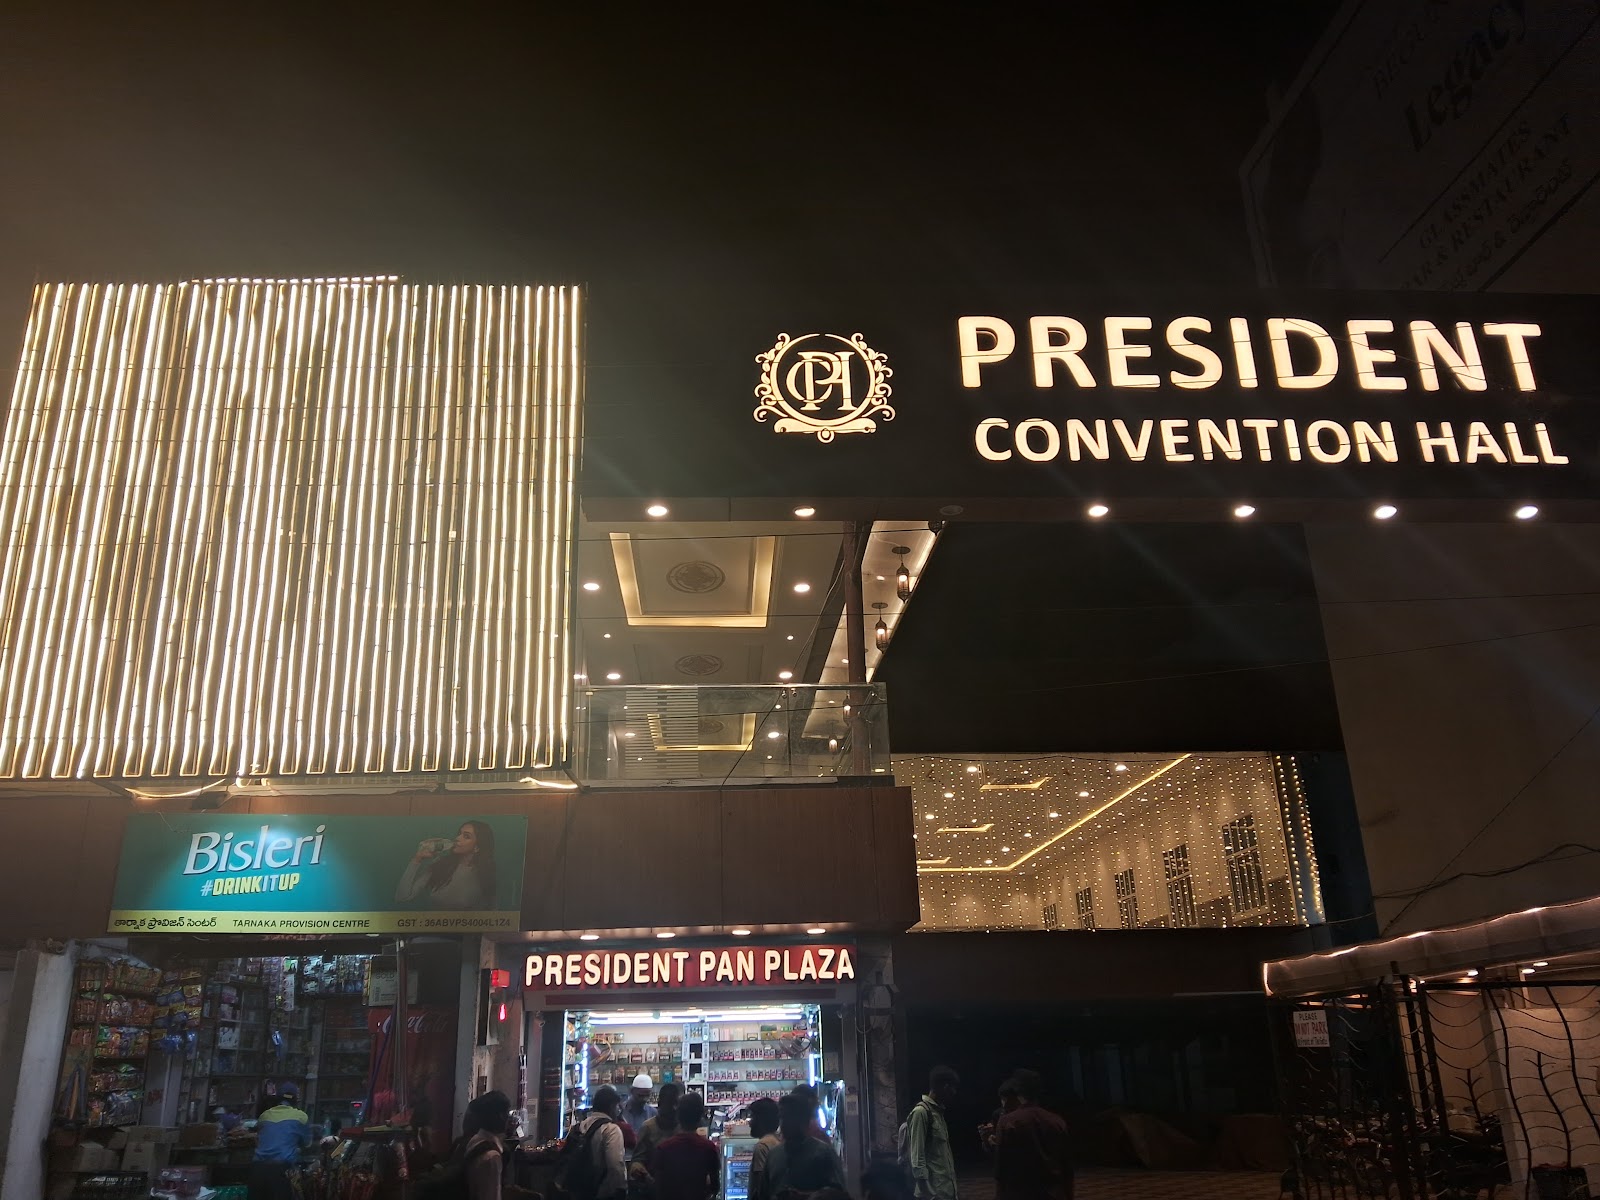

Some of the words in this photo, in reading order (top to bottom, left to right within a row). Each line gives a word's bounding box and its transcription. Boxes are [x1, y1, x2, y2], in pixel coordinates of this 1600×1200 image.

[958, 316, 1541, 392] PRESIDENT
[976, 418, 1398, 463] CONVENTION
[1416, 422, 1568, 465] HALL
[183, 824, 326, 875] Bisleri
[200, 873, 300, 897] #DRINKITUP
[233, 919, 277, 928] TARNAKA
[279, 919, 329, 928] PROVISION
[332, 919, 370, 928] CENTRE
[397, 918, 416, 927] GST
[526, 951, 689, 985] PRESIDENT
[700, 951, 756, 982] PAN
[766, 949, 855, 981] PLAZA
[1311, 1021, 1328, 1034] PARK
